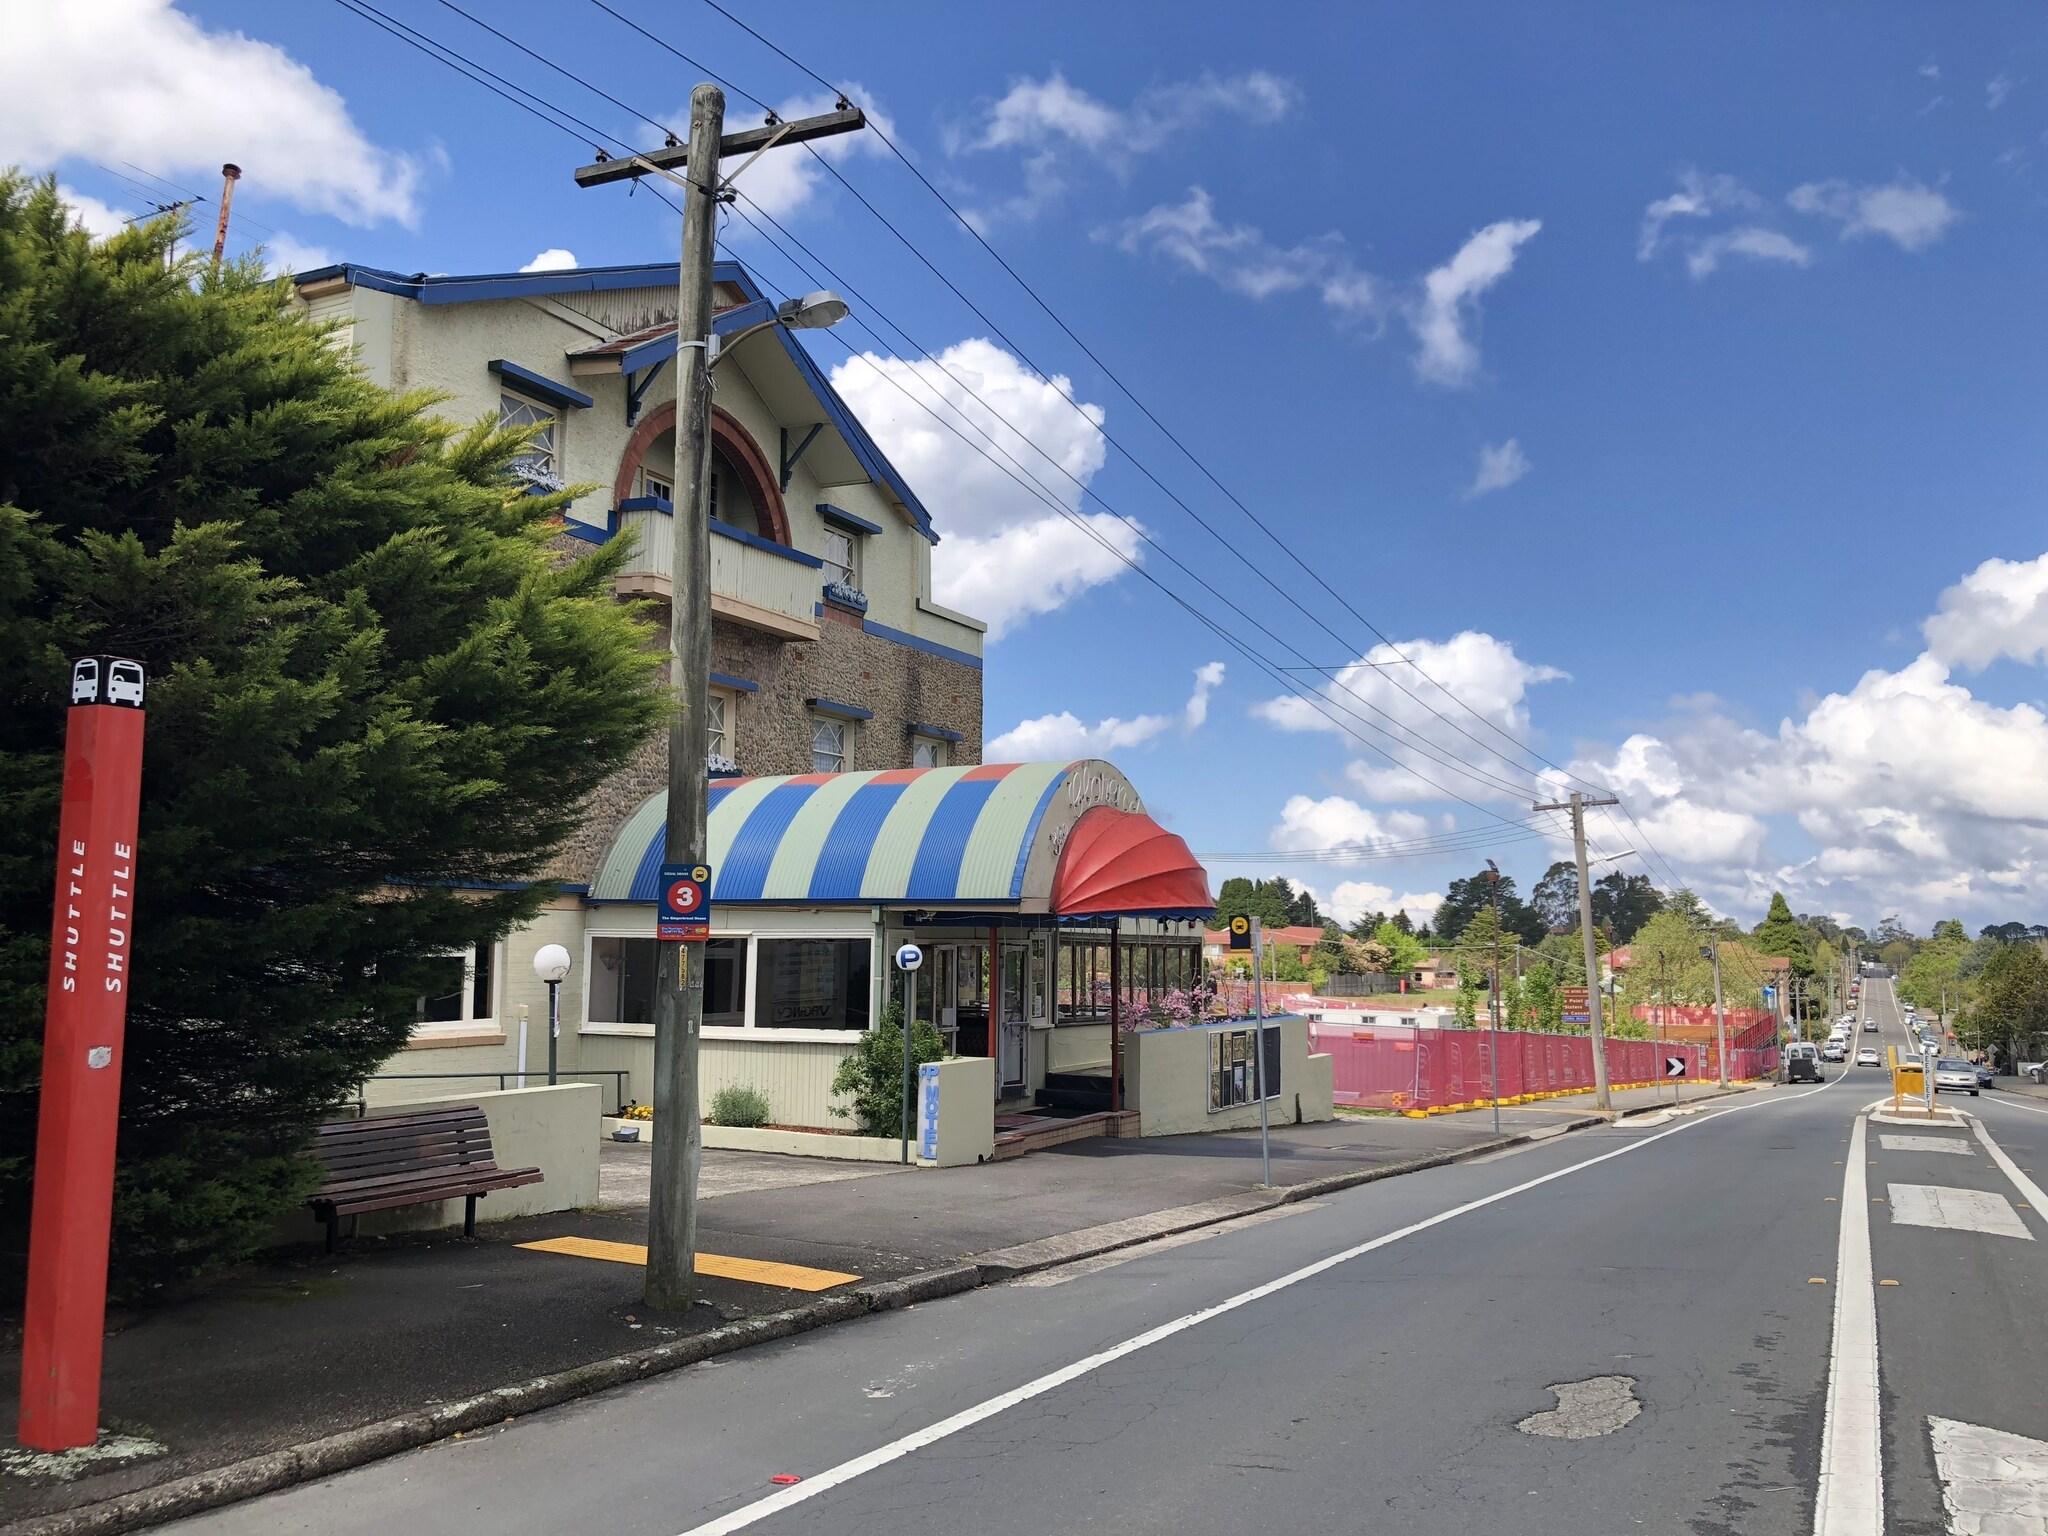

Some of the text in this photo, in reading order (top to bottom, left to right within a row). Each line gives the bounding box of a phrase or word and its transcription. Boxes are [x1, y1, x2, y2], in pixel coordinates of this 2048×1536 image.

[63, 840, 86, 993] SHUTTLE
[105, 842, 131, 993] SHUTTLE
[677, 887, 693, 906] 3
[901, 949, 920, 969] P
[924, 1085, 939, 1159] MOTEL
